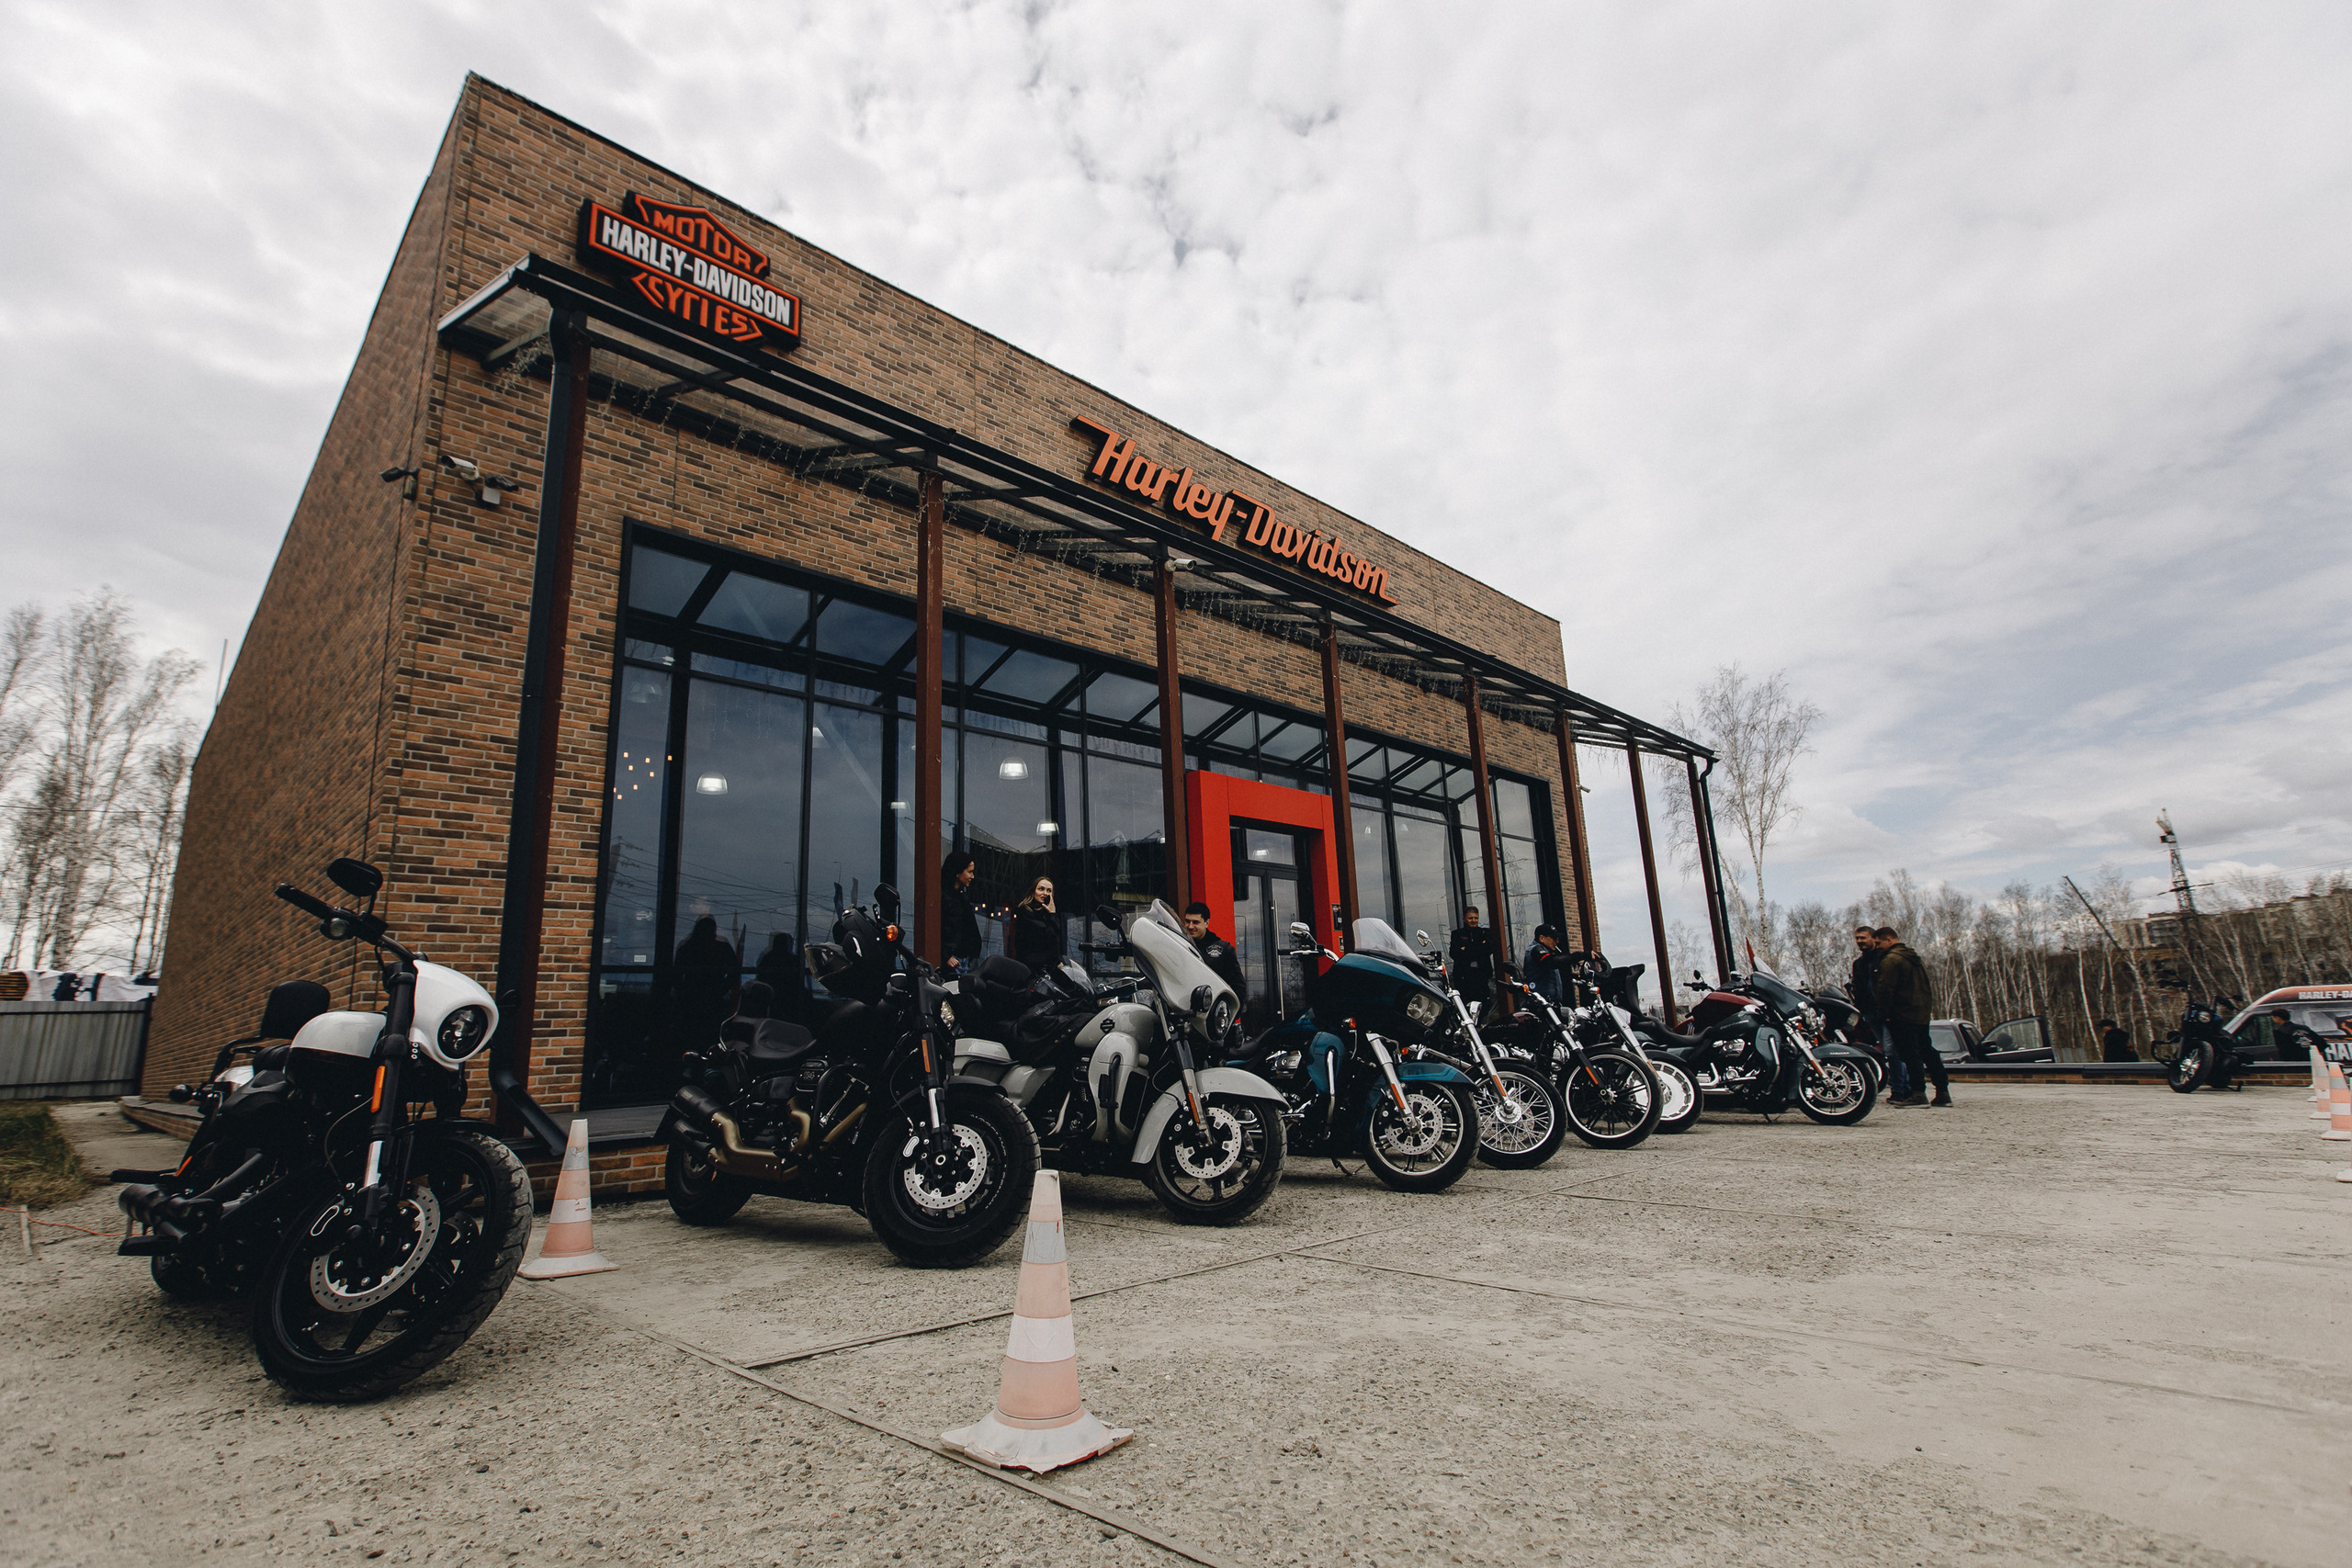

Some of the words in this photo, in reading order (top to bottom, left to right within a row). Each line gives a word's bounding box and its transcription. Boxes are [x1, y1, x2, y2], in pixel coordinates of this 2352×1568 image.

[602, 216, 790, 326] HARLEY-DAVIDSON
[653, 209, 751, 271] MOTOR
[1076, 414, 1400, 605] Harley-Davidson
[2324, 1042, 2352, 1061] HA
